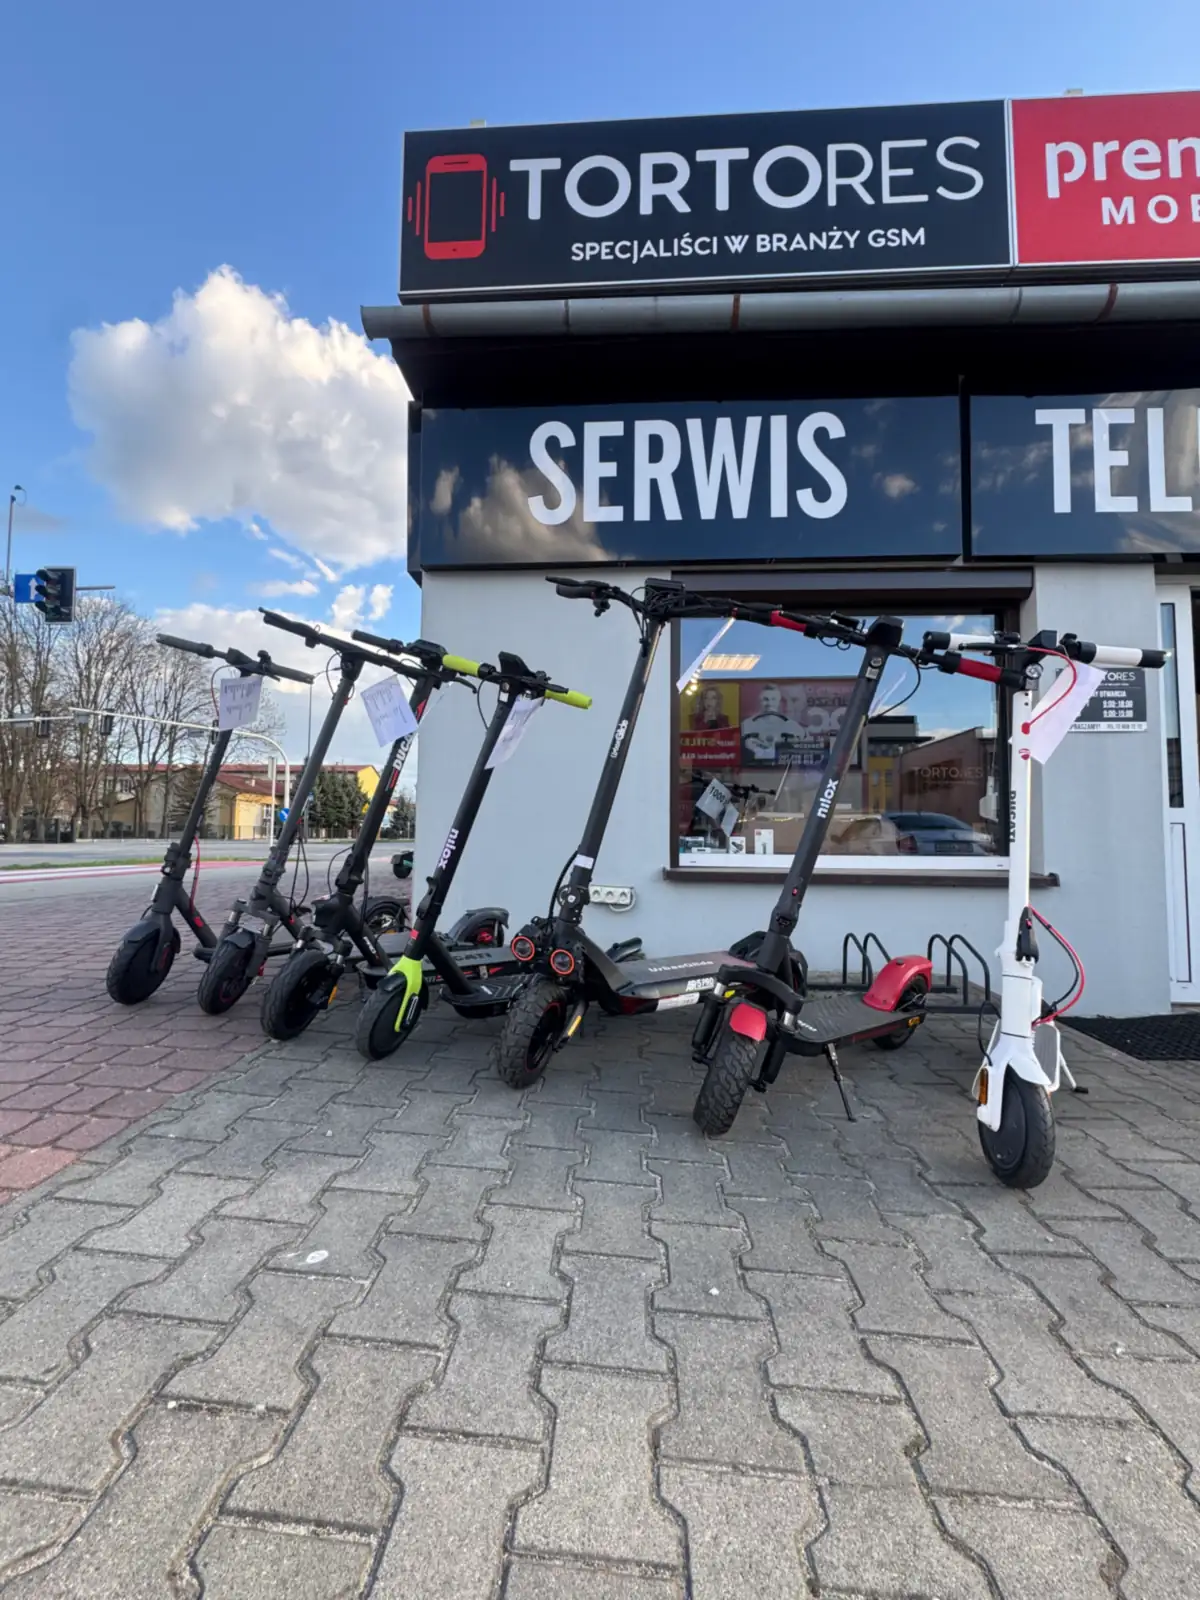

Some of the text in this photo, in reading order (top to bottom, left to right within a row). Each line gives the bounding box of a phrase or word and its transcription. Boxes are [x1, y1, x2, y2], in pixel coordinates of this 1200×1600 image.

[509, 136, 984, 221] TORTORES
[571, 226, 926, 264] SPECJALIŚCI W BRANŻY GSM
[527, 411, 849, 526] SERWIS
[1035, 407, 1200, 513] TEL
[392, 733, 414, 771] DUCA
[817, 778, 839, 819] nilox
[438, 828, 460, 870] nilox
